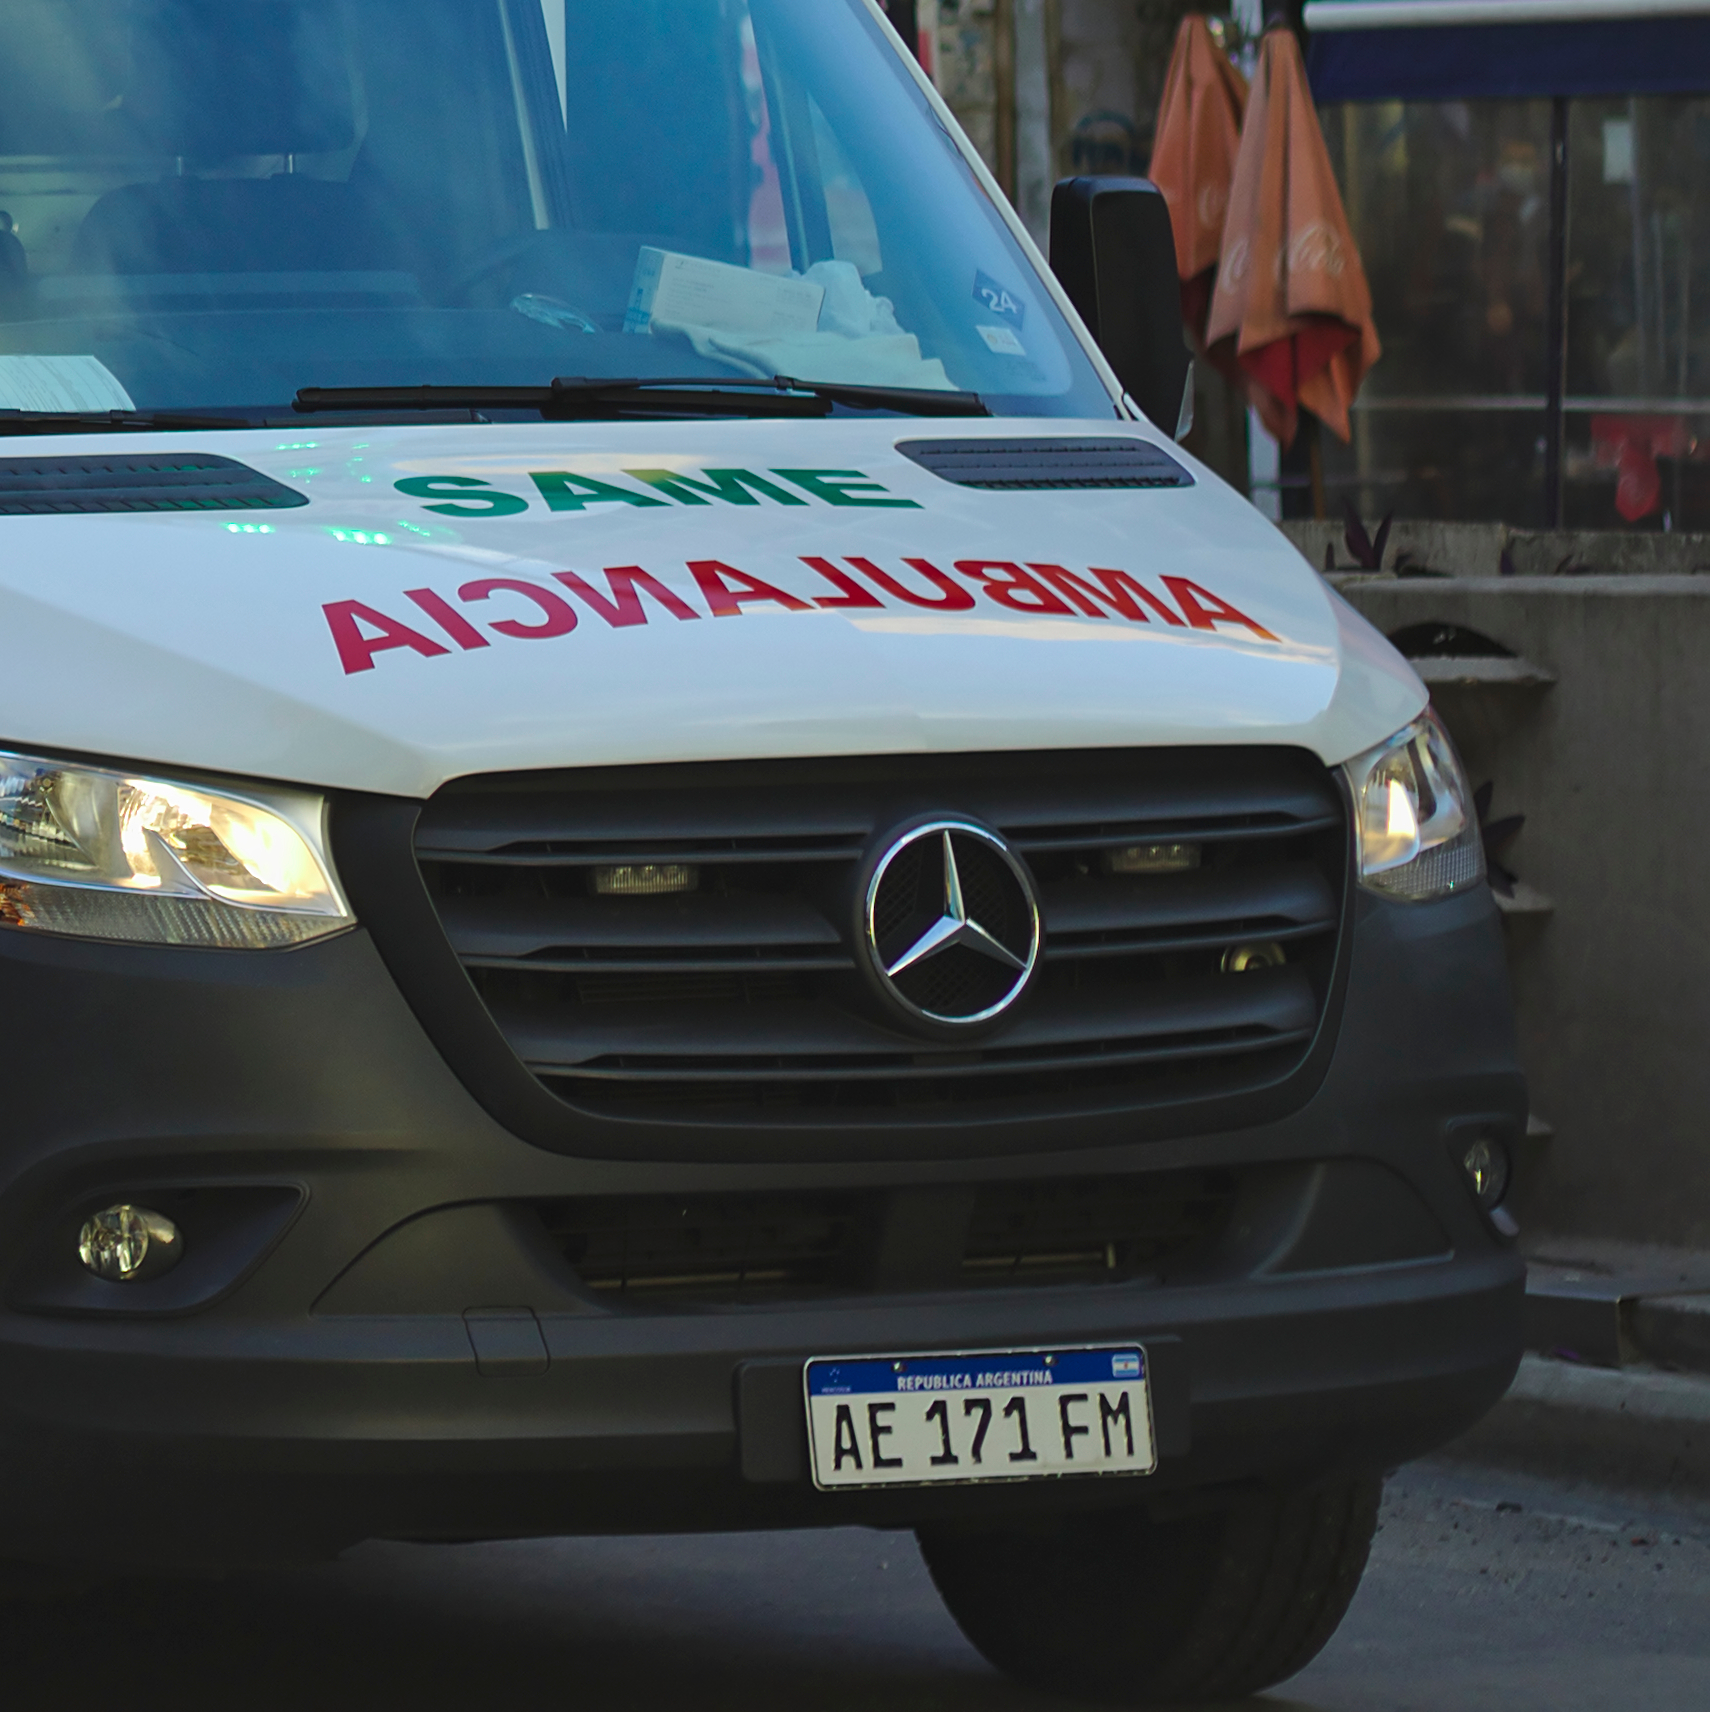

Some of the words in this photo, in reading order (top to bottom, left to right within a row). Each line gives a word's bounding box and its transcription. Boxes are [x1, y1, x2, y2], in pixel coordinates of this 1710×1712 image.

[393, 467, 924, 518] SAME
[897, 1374, 972, 1391] REPUBLICA
[976, 1369, 1054, 1387] ARGENTINA
[832, 1401, 903, 1472] AE
[924, 1395, 1038, 1466] 171
[1057, 1390, 1135, 1460] FM
